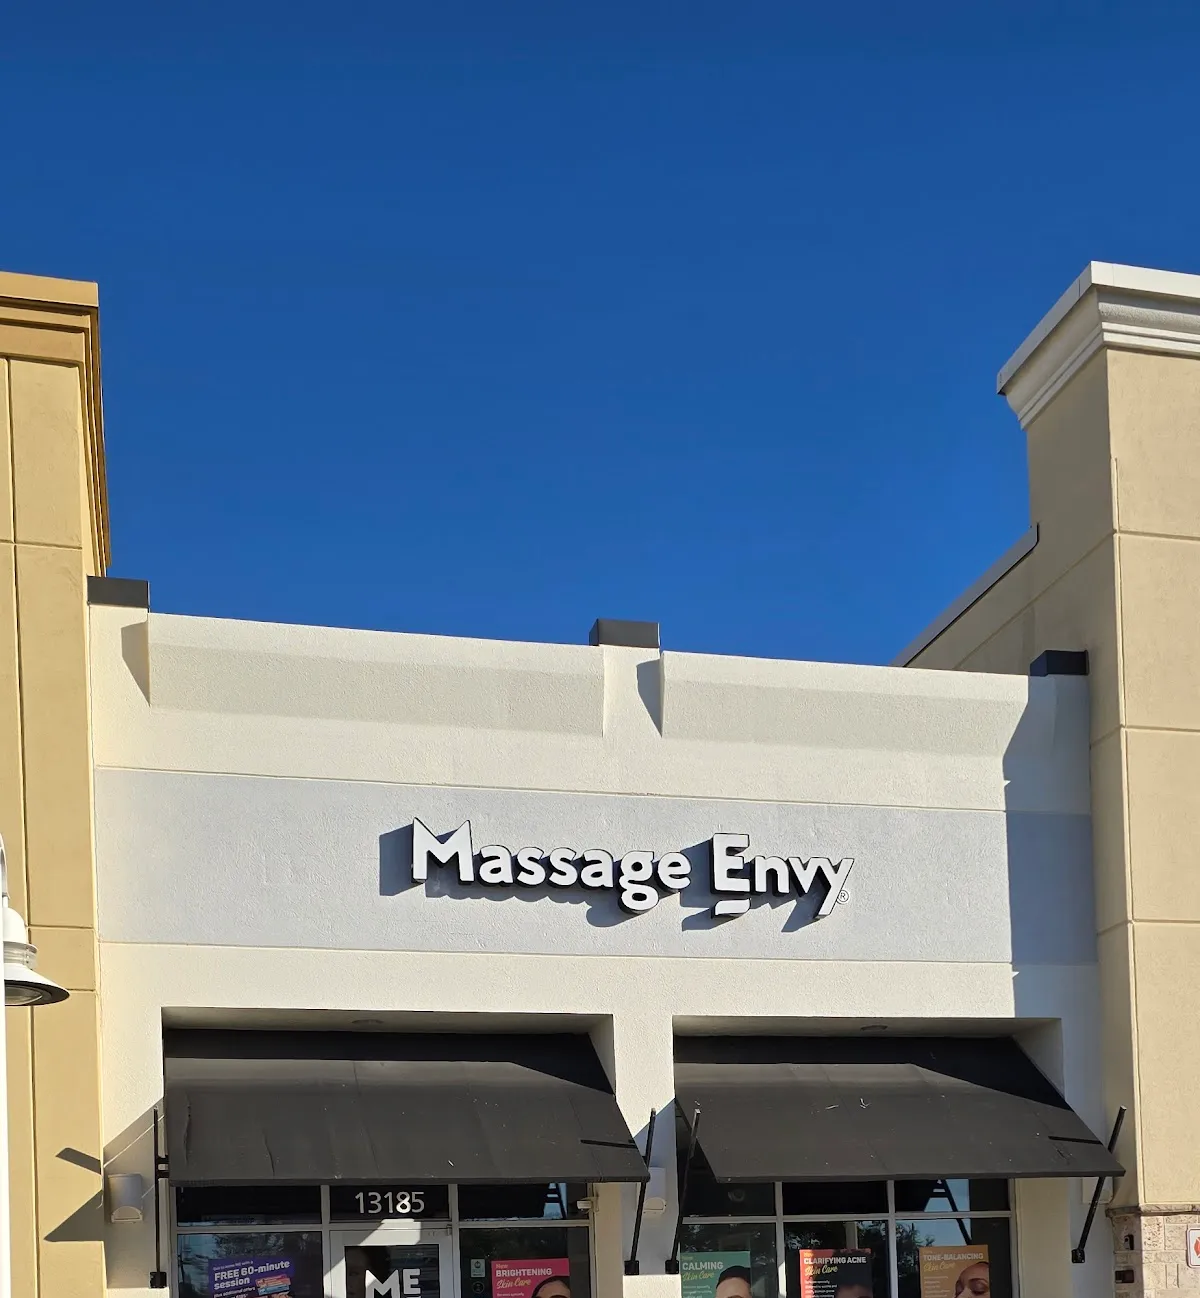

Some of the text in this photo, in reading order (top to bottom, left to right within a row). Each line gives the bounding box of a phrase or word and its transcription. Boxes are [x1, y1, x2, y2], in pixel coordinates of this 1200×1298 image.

[411, 816, 855, 920] Massage Envy
[355, 1191, 425, 1214] 13185
[803, 1256, 866, 1265] CLARIFYING ACNE
[923, 1252, 983, 1261] TONE-BALANCING
[214, 1260, 290, 1281] FREE 60-minute
[682, 1262, 724, 1270] CALMING
[804, 1264, 838, 1276] Skin Care
[923, 1261, 956, 1272] Skin Care
[496, 1268, 552, 1277] BRIGHTENING
[682, 1270, 714, 1281] Skin Care
[213, 1277, 250, 1290] session
[496, 1277, 531, 1289] Skin Care
